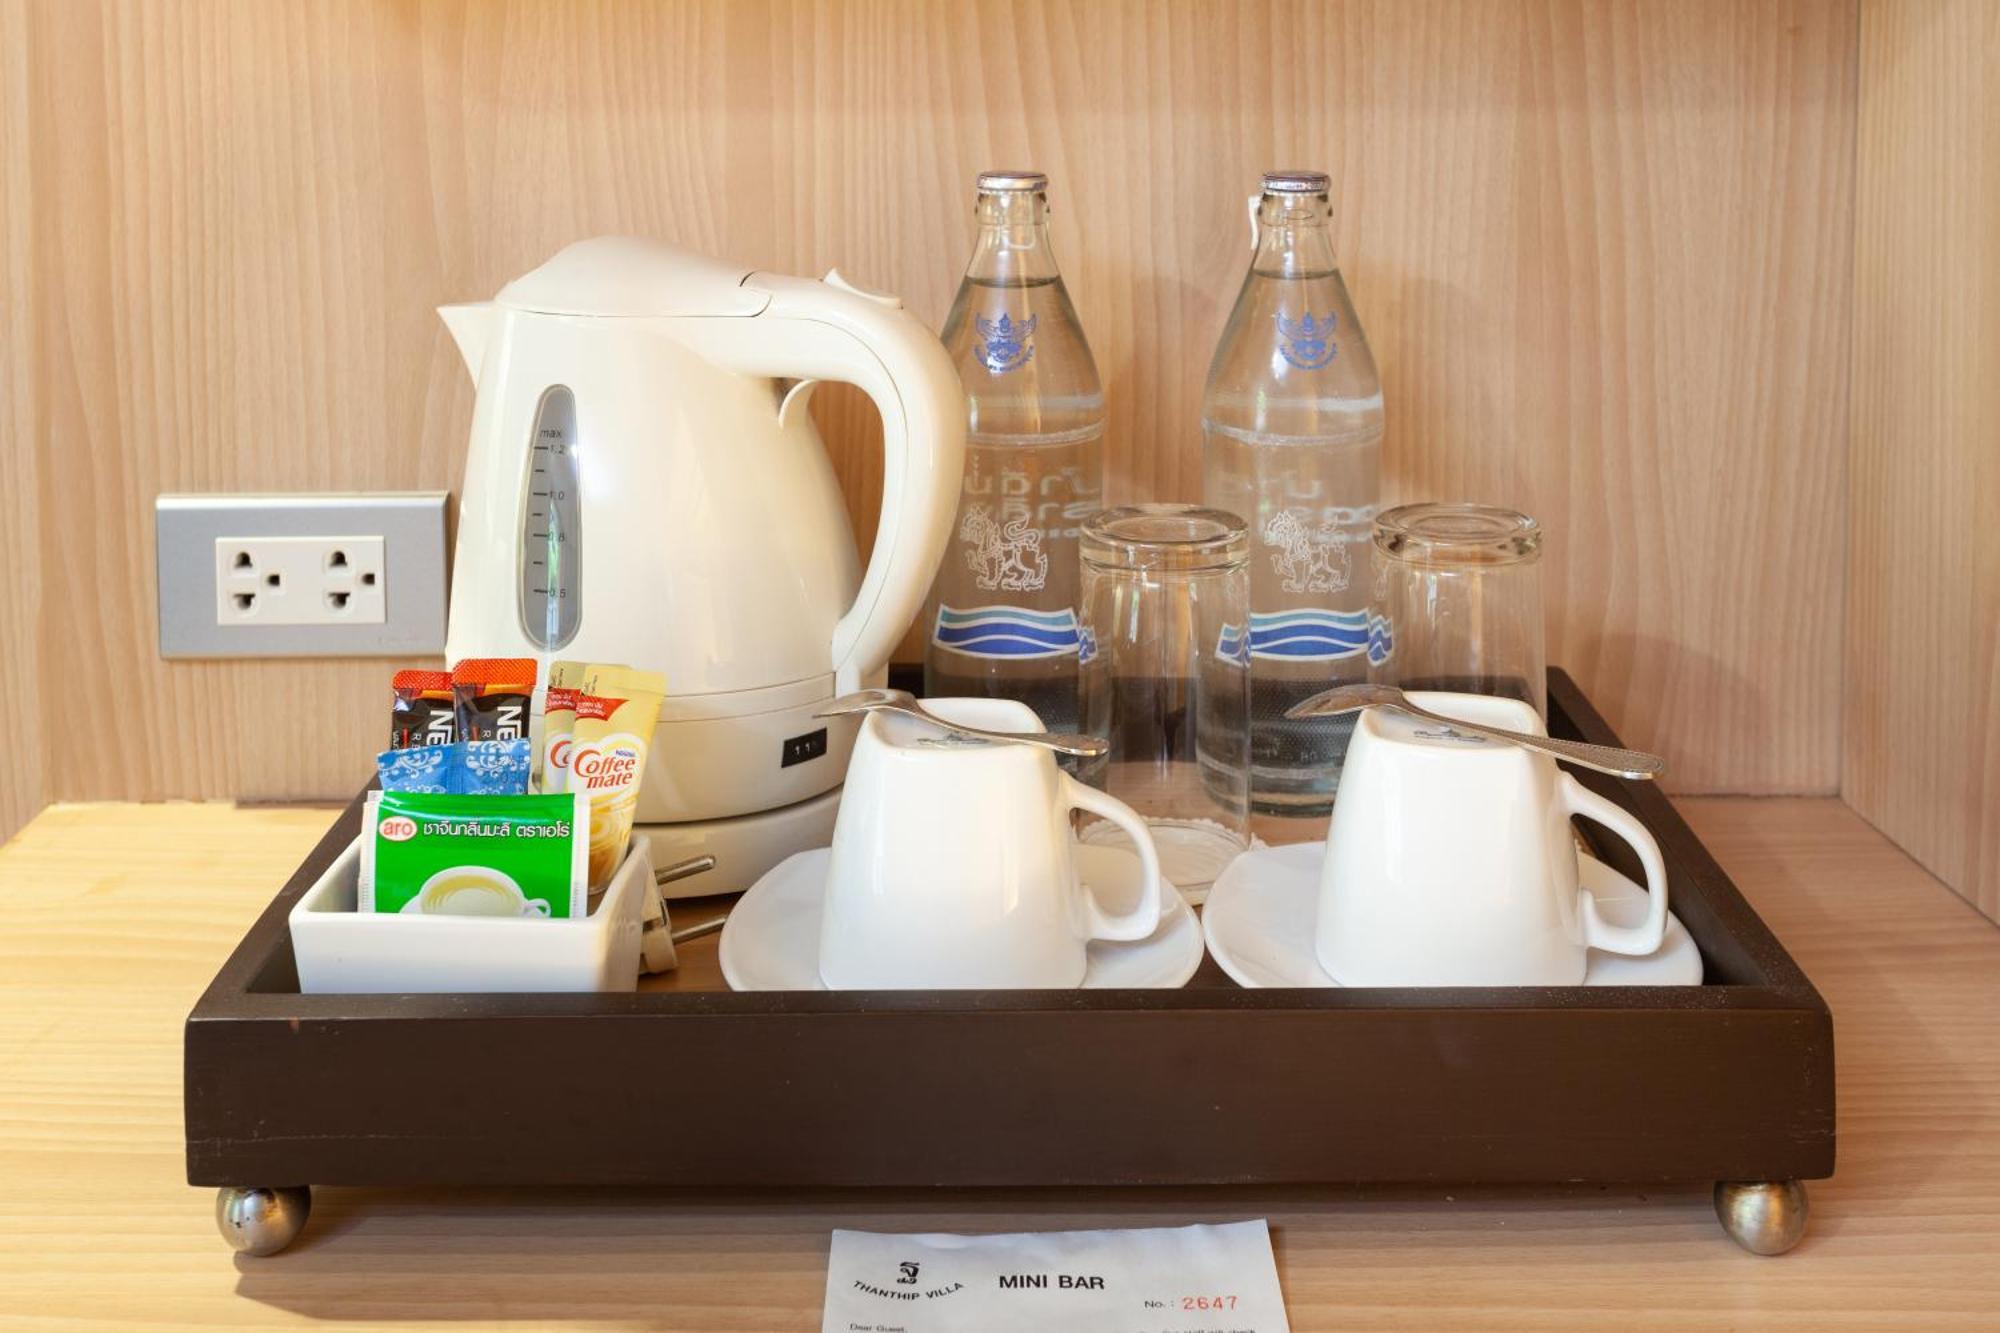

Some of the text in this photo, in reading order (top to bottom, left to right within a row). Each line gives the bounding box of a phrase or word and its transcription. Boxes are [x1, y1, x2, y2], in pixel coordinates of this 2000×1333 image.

[540, 429, 562, 438] max
[574, 749, 636, 778] Coffee
[586, 772, 633, 789] mate
[383, 821, 413, 836] aro
[853, 1280, 964, 1300] THANTHIP VILLA
[999, 1274, 1106, 1291] MINI BAR
[1182, 1295, 1238, 1310] 2647
